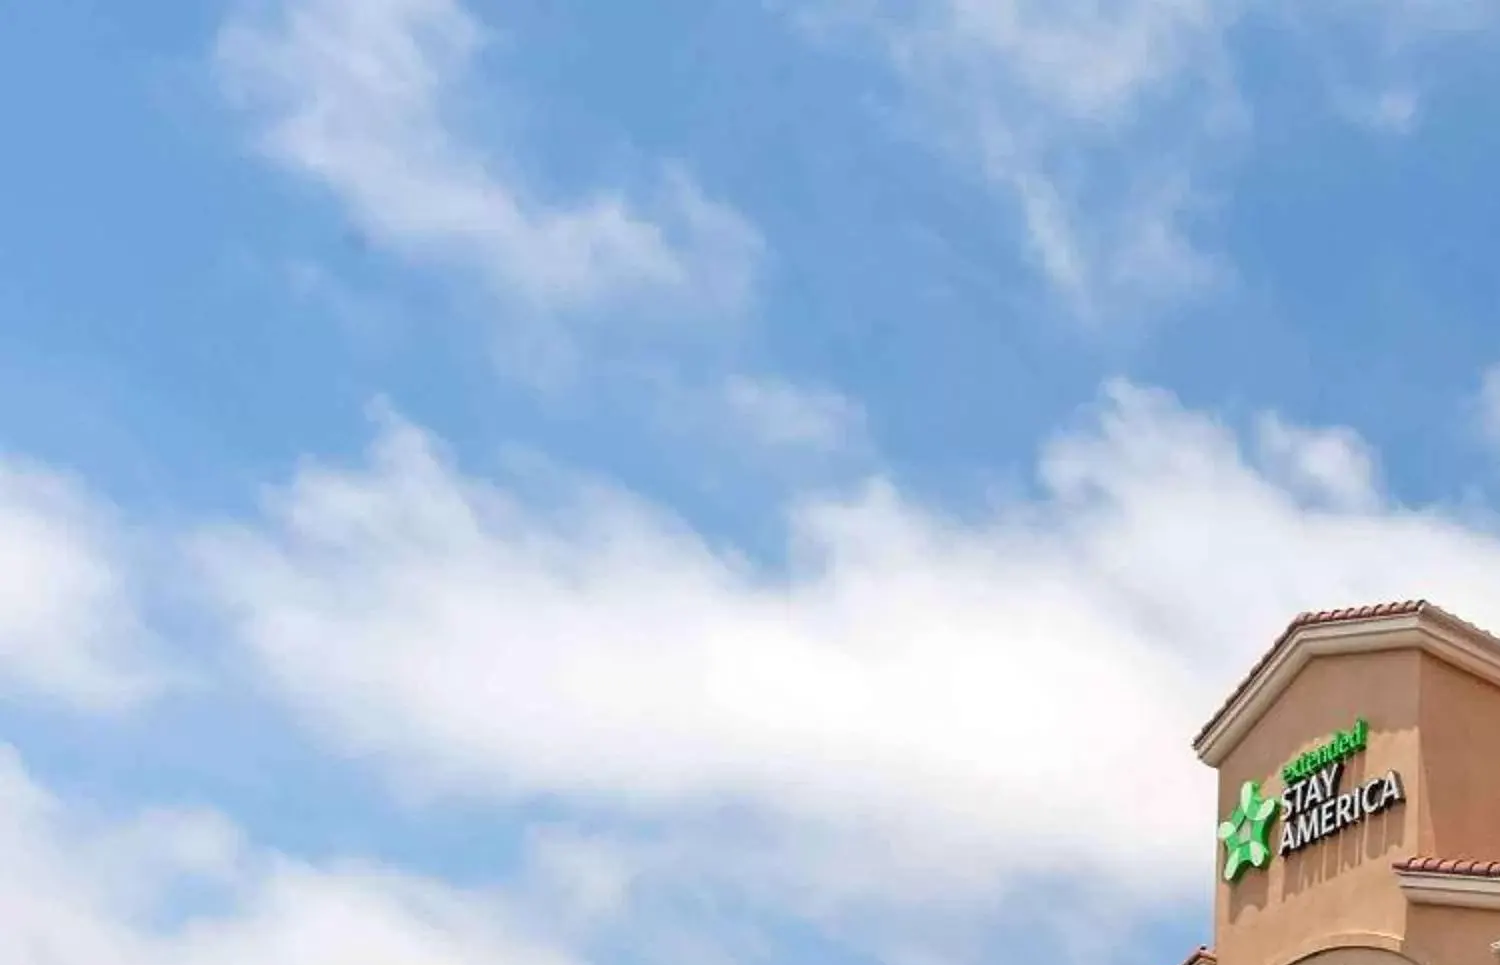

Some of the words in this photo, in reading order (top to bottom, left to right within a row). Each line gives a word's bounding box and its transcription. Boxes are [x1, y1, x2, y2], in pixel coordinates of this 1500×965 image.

[1281, 717, 1367, 781] extended
[1278, 768, 1402, 855] AMERICA
[1280, 763, 1339, 821] STAY
